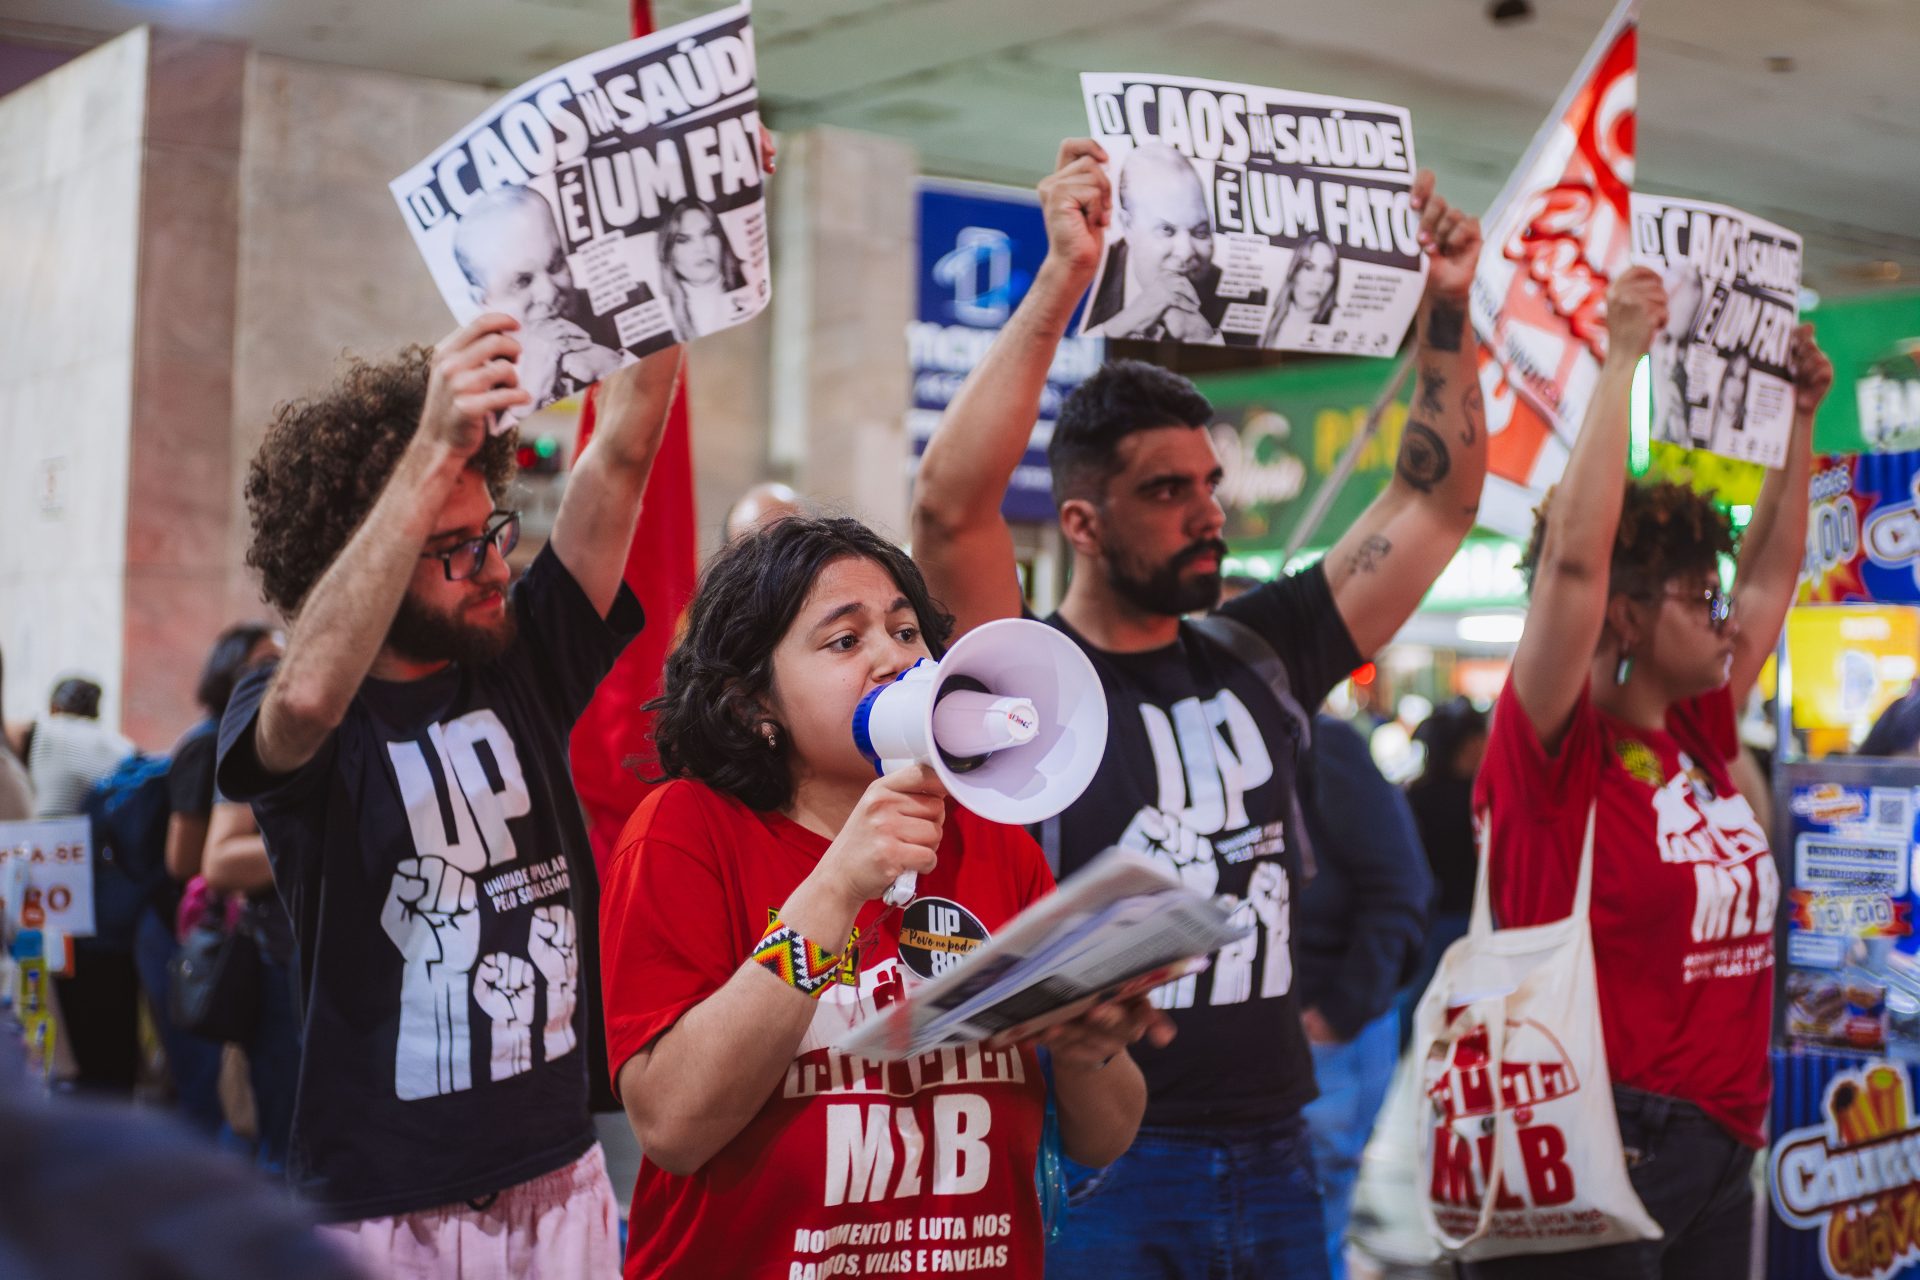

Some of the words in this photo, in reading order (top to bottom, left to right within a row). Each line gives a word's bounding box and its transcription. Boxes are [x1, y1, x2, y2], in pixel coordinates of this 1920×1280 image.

[411, 187, 444, 228] O
[436, 81, 589, 219] CAOS
[576, 88, 623, 137] NA
[605, 29, 756, 135] SAÚD
[1095, 93, 1125, 134] O
[1124, 84, 1251, 165] CAOS
[1270, 110, 1409, 172] SAÚDE
[560, 172, 590, 243] É
[592, 139, 687, 227] UM
[1215, 172, 1243, 230] É
[1247, 170, 1319, 237] UM
[1320, 181, 1422, 257] FATO
[387, 708, 531, 874] UP
[1139, 688, 1274, 835] UP
[492, 890, 518, 913] PELO
[909, 930, 934, 945] Povo
[928, 904, 961, 937] UP
[824, 1093, 992, 1207] MLB
[788, 1253, 861, 1280] BAIOS,
[865, 1249, 912, 1275] VILAS
[916, 1249, 927, 1273] E
[931, 1245, 1009, 1273] FAVELAS
[794, 1222, 892, 1254] MOMENTO
[895, 1218, 912, 1242] DE
[919, 1217, 967, 1240] LUTA
[973, 1213, 1011, 1239] NOS
